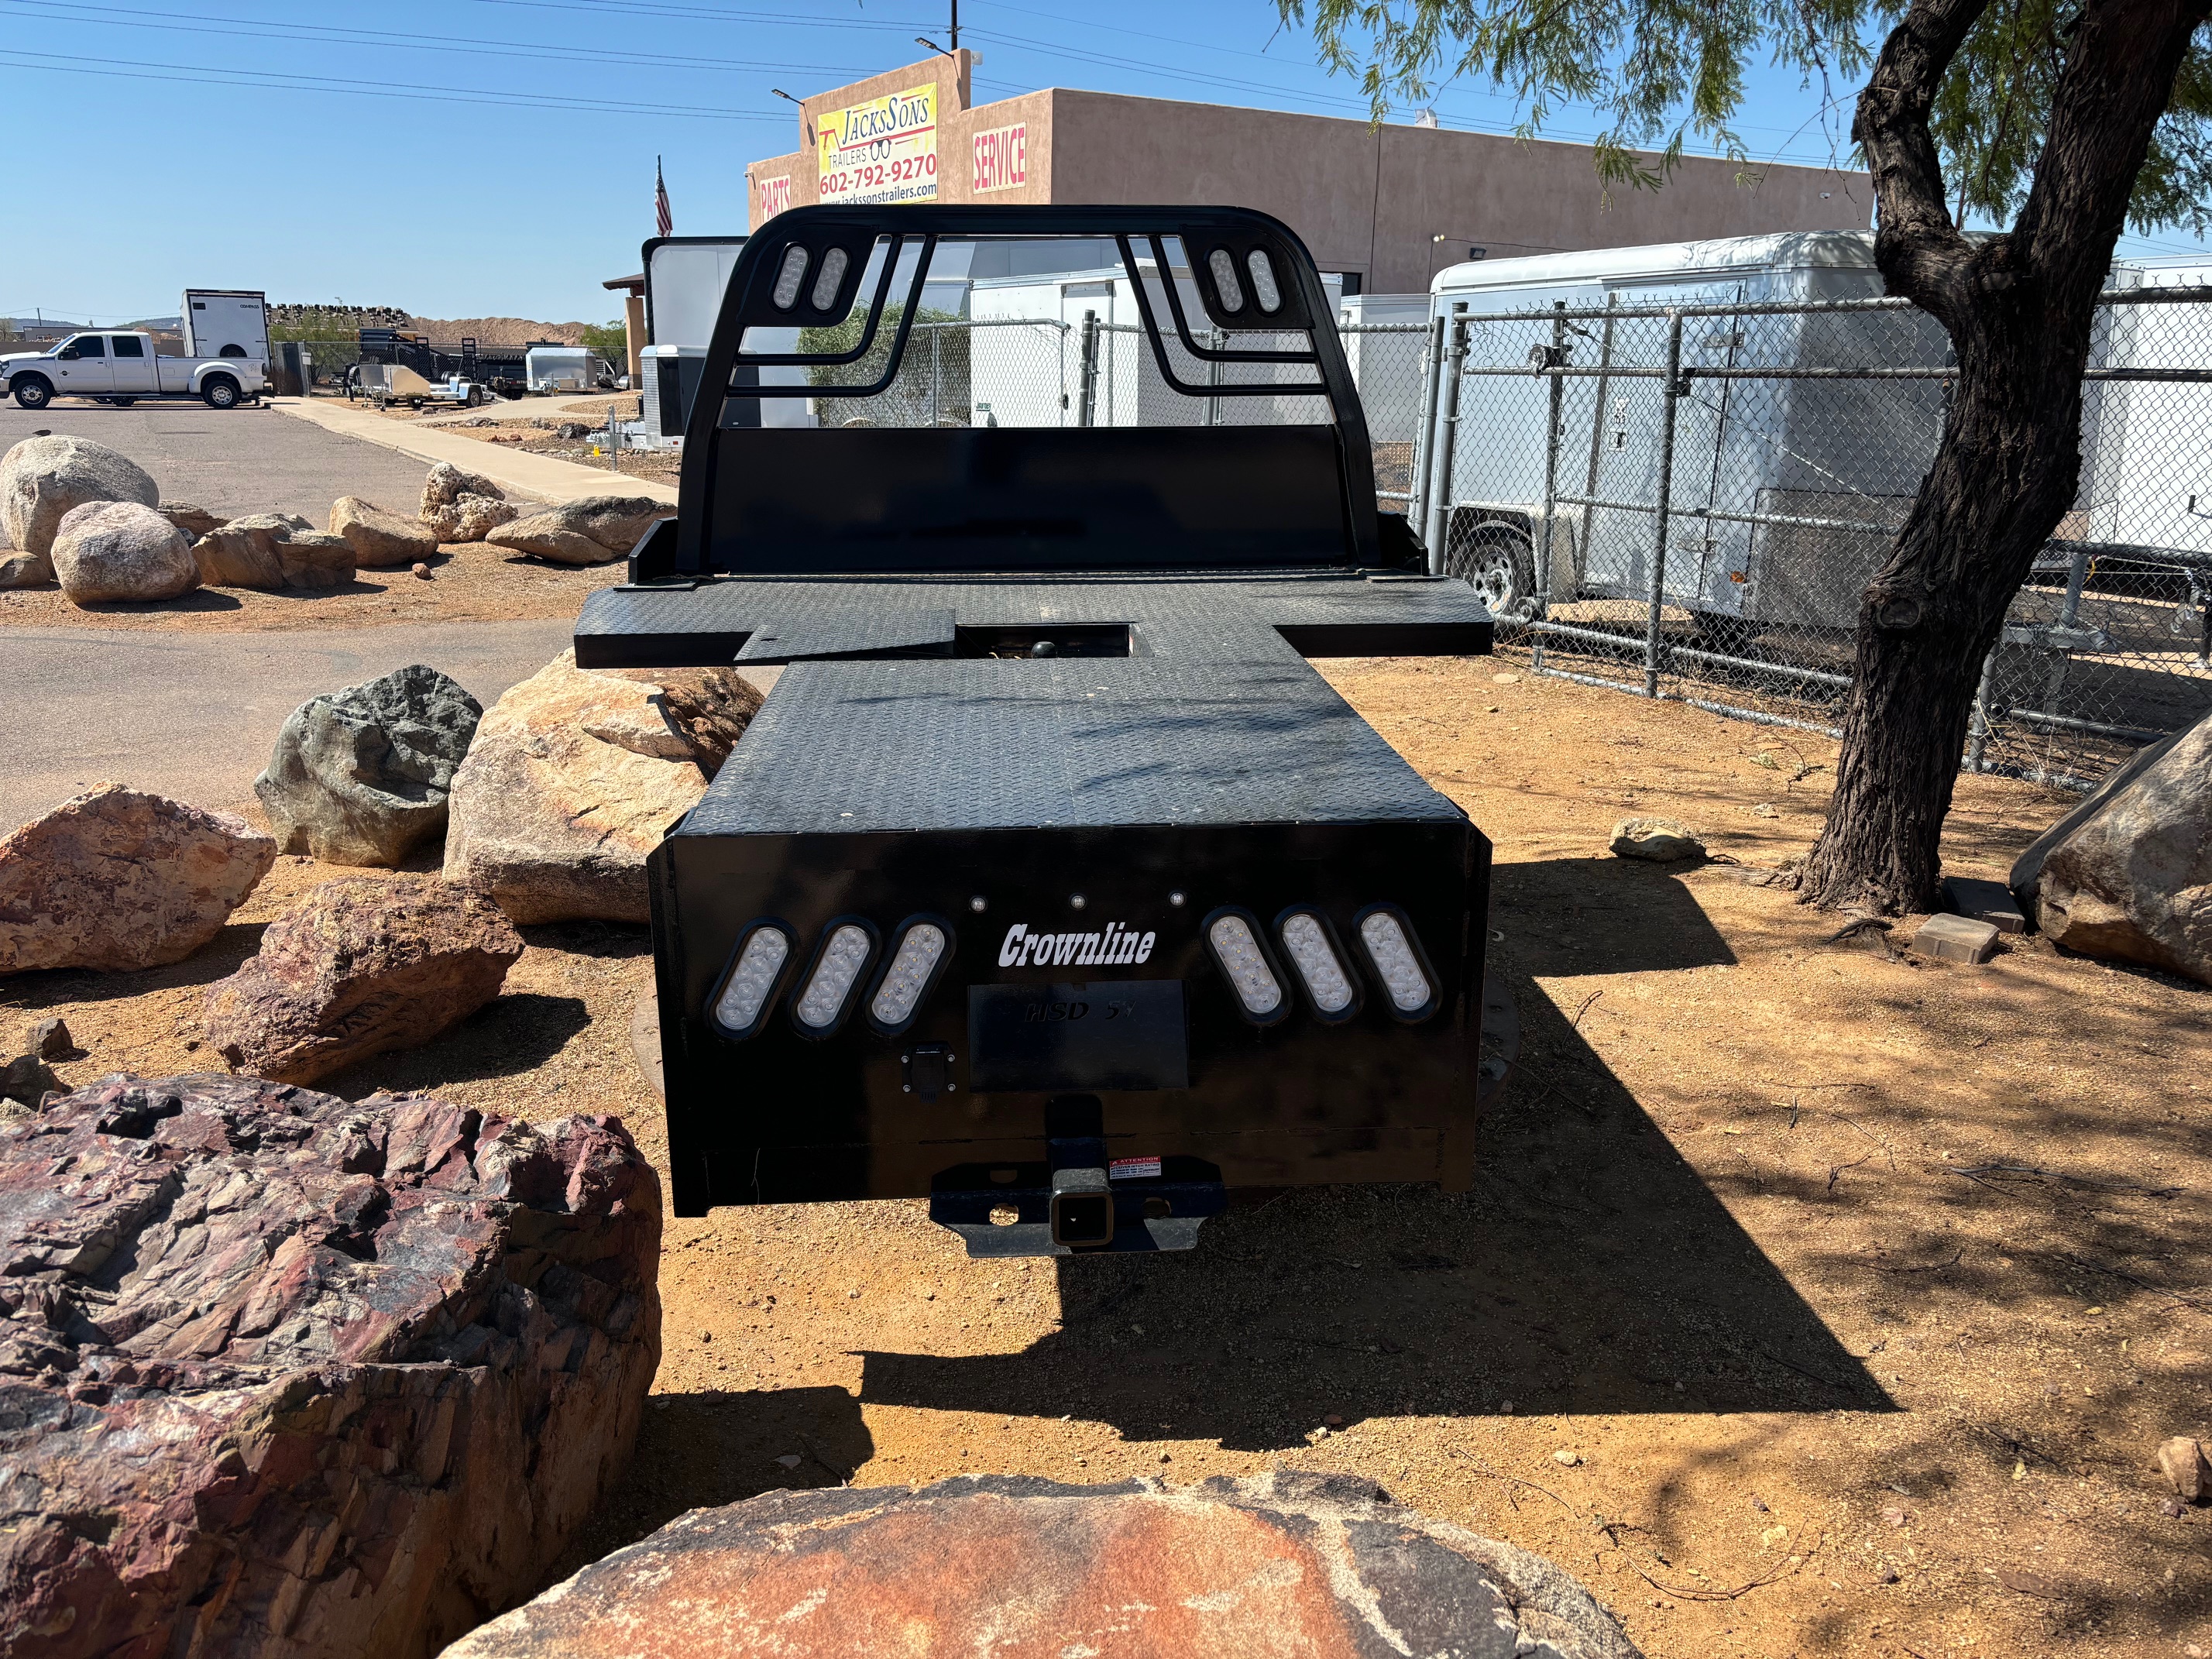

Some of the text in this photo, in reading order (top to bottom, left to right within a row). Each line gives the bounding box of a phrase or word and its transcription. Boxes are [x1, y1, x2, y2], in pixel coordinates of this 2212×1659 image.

[819, 153, 936, 195] 602-792-9270
[828, 148, 867, 169] TRAILERS
[974, 127, 1025, 191] SERVICE
[761, 177, 791, 223] PARTS
[998, 922, 1156, 967] Crownline
[1024, 1001, 1091, 1022] HSD
